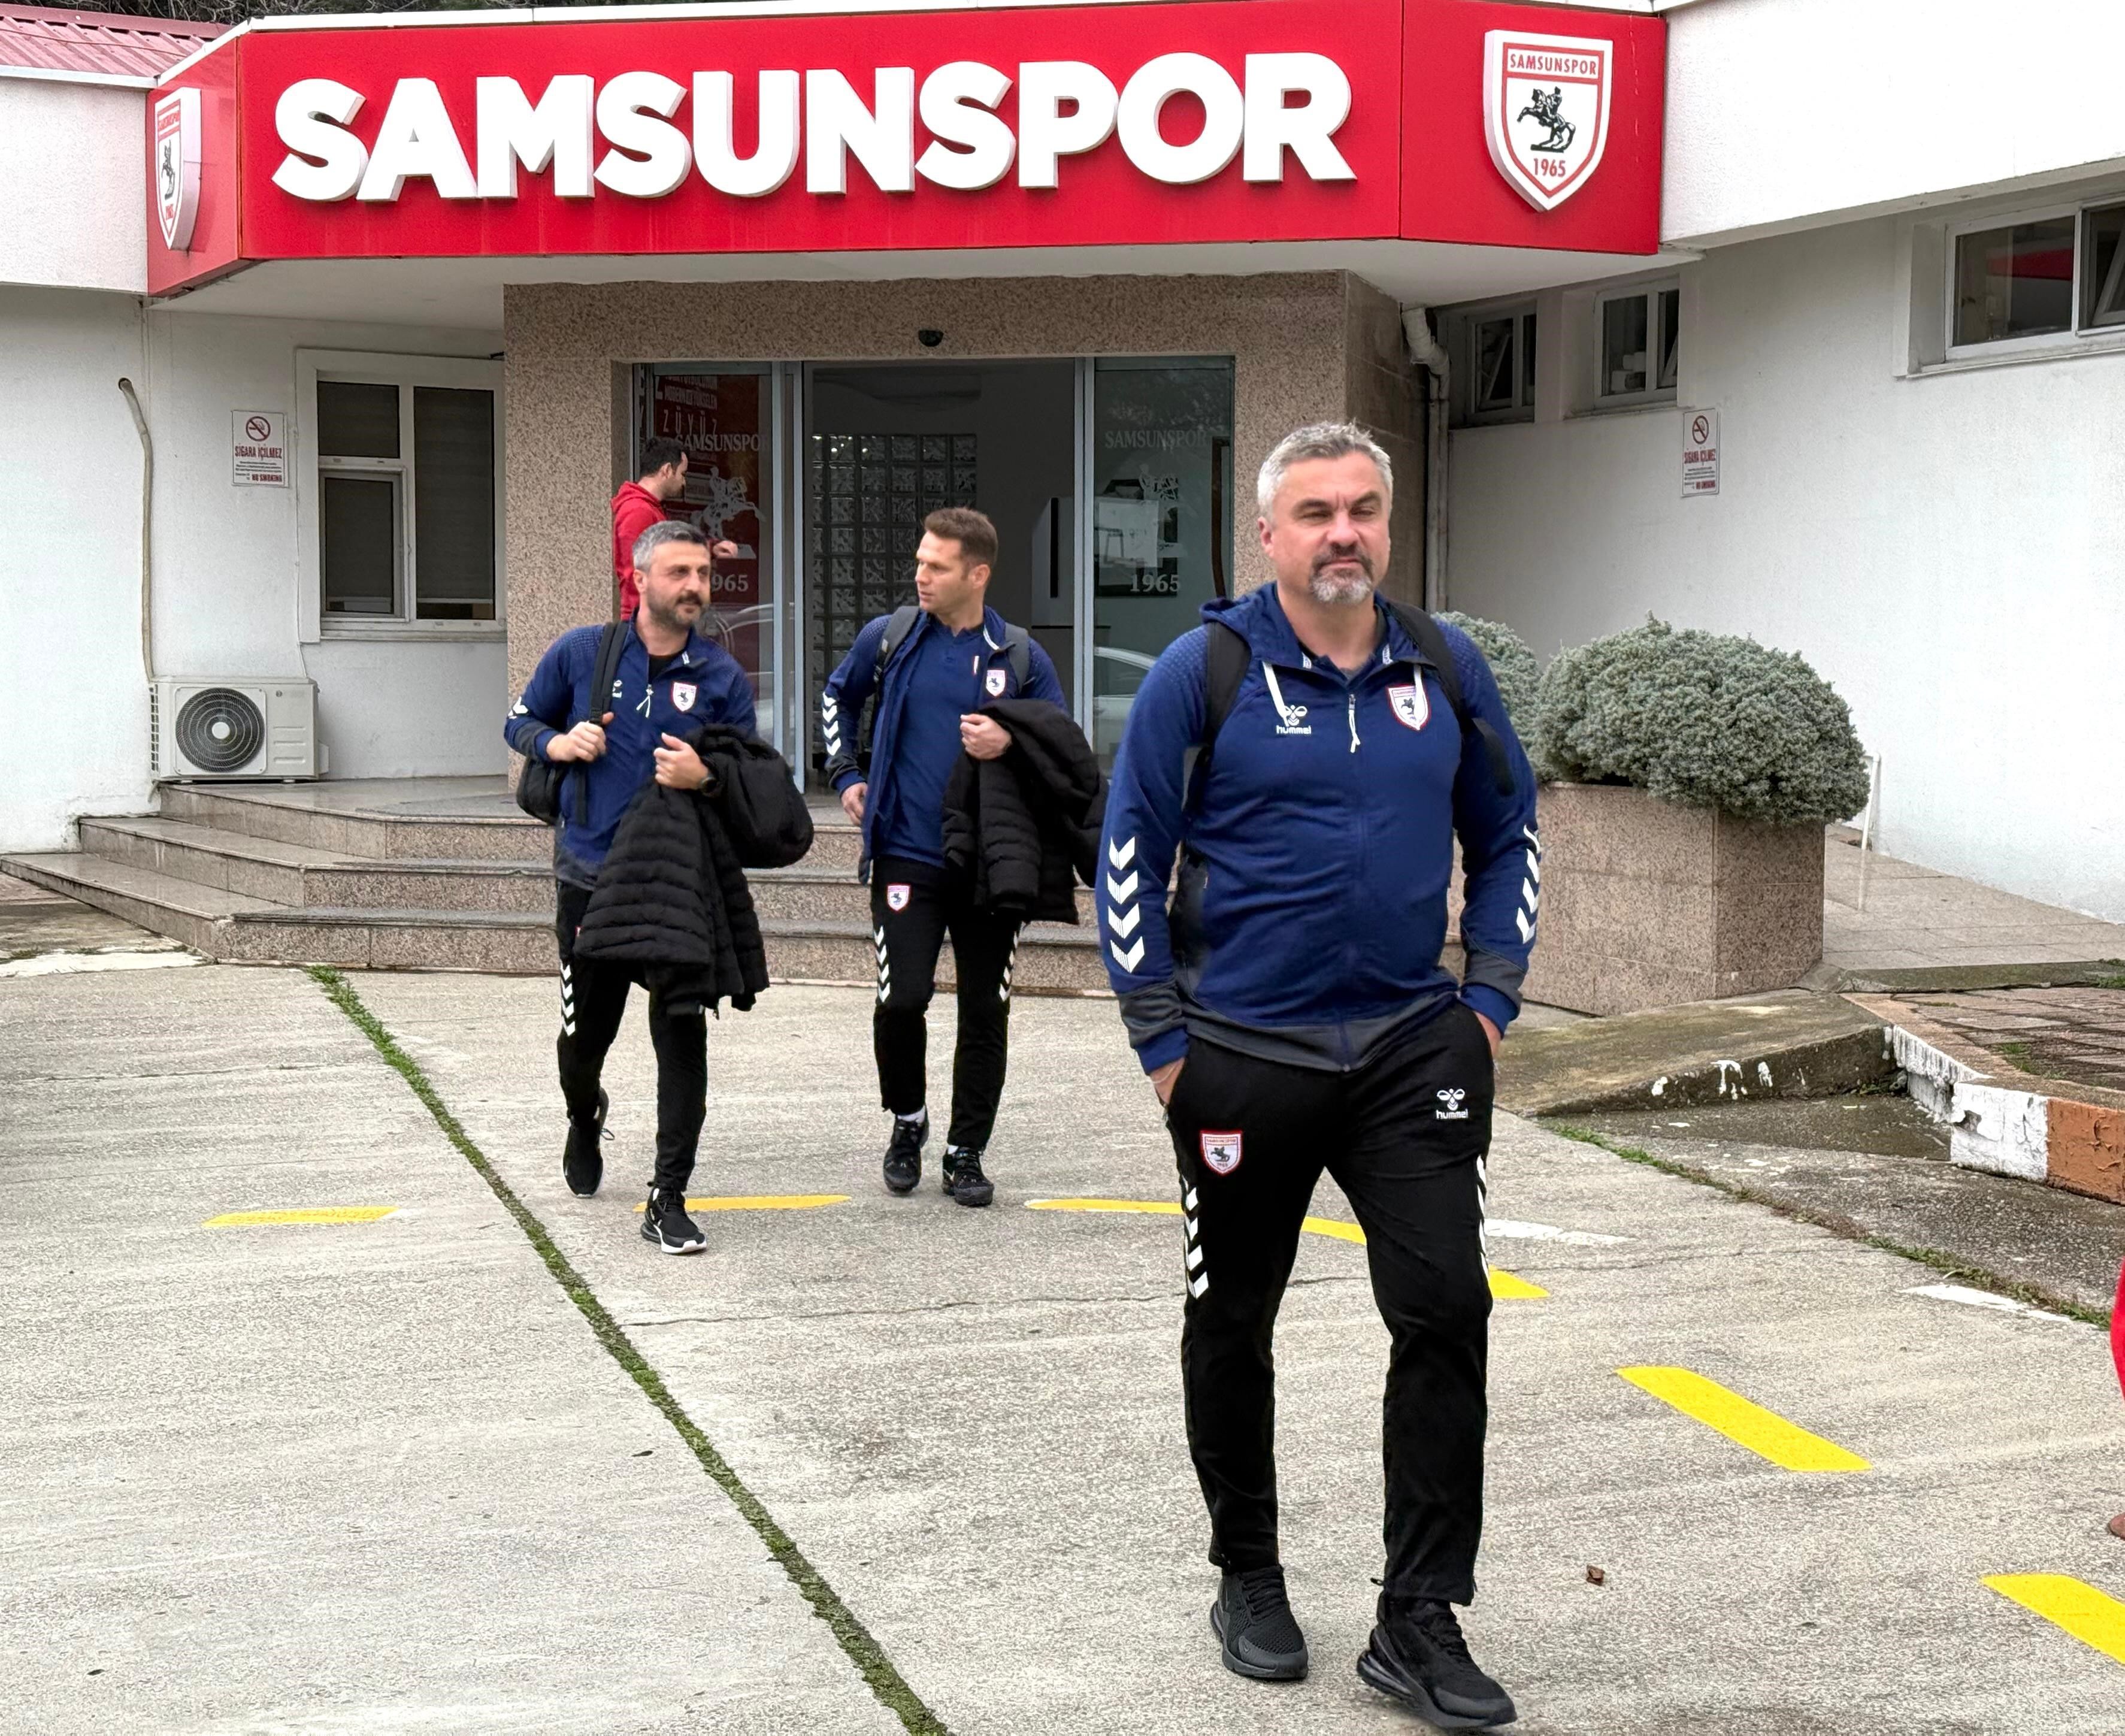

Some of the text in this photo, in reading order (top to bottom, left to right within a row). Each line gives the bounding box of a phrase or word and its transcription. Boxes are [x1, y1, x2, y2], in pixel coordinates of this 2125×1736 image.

[1509, 53, 1597, 75] SAMSUNSPOR
[271, 52, 1357, 202] SAMSUNSPOR
[1533, 158, 1566, 177] 1965
[1105, 430, 1209, 448] SAMSUNSPOR
[711, 573, 749, 592] 965
[1130, 574, 1181, 592] 1965
[1276, 725, 1312, 734] hummel
[1436, 1108, 1469, 1120] hummel
